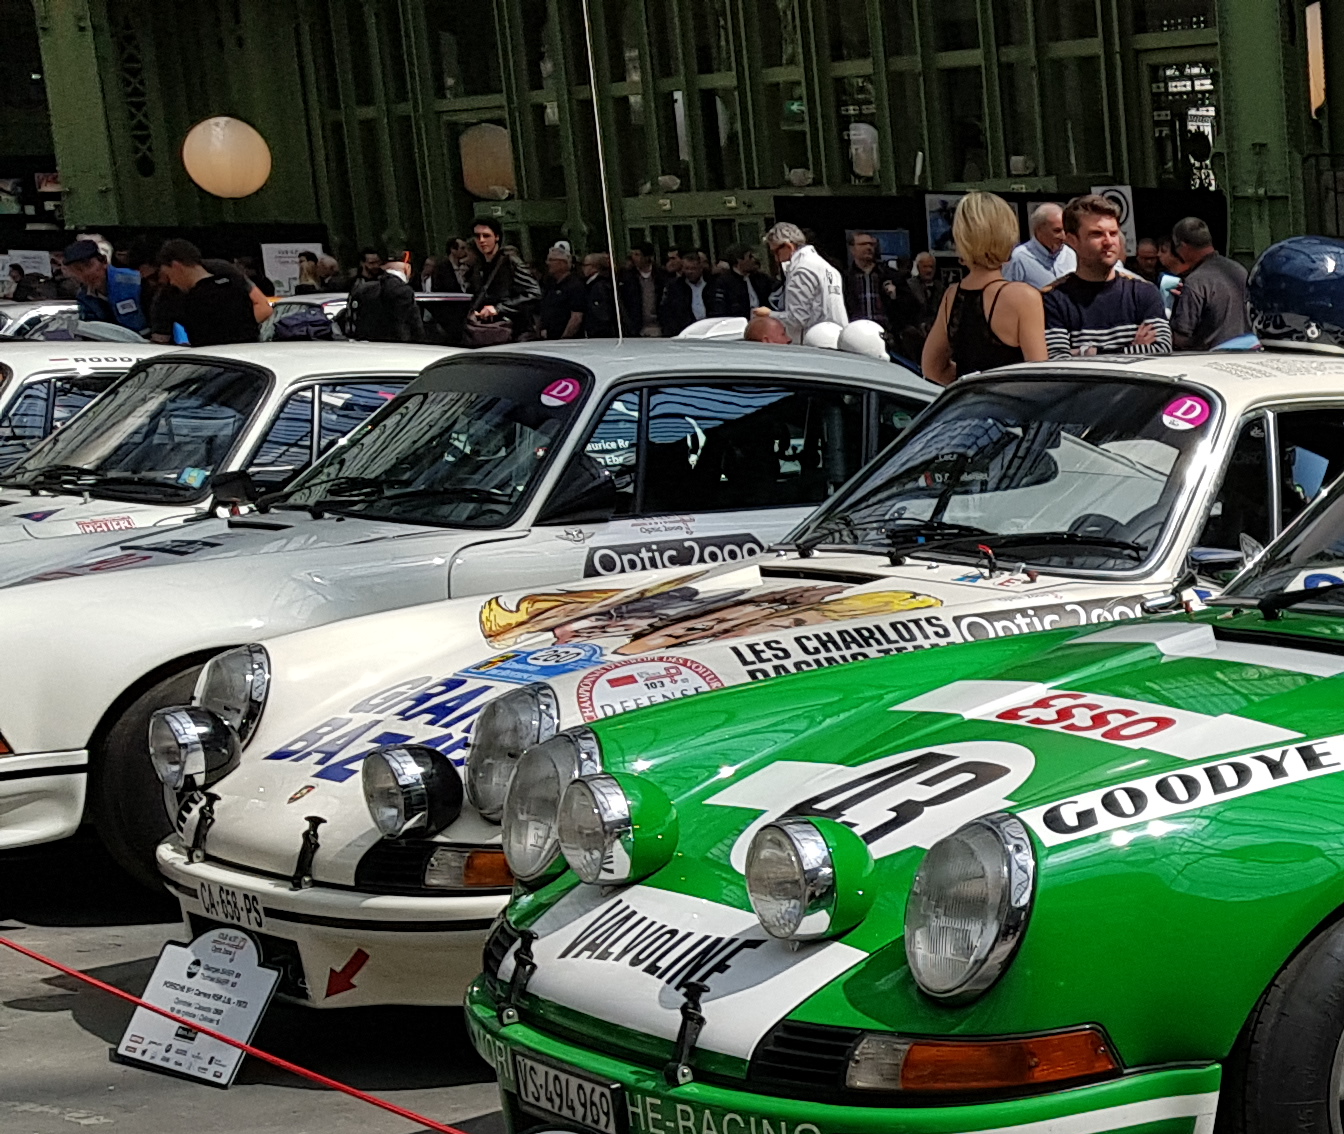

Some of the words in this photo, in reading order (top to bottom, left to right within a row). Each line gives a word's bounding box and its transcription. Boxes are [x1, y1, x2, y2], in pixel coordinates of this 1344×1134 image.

[551, 380, 574, 397] D
[1173, 400, 1202, 419] D
[593, 545, 681, 576] Optic
[730, 639, 791, 667] LES
[794, 615, 952, 661] CHARLOTS
[530, 649, 581, 665] 260
[644, 680, 665, 690] 103
[995, 692, 1177, 743] ESSO
[556, 897, 769, 995] VALVOLINE
